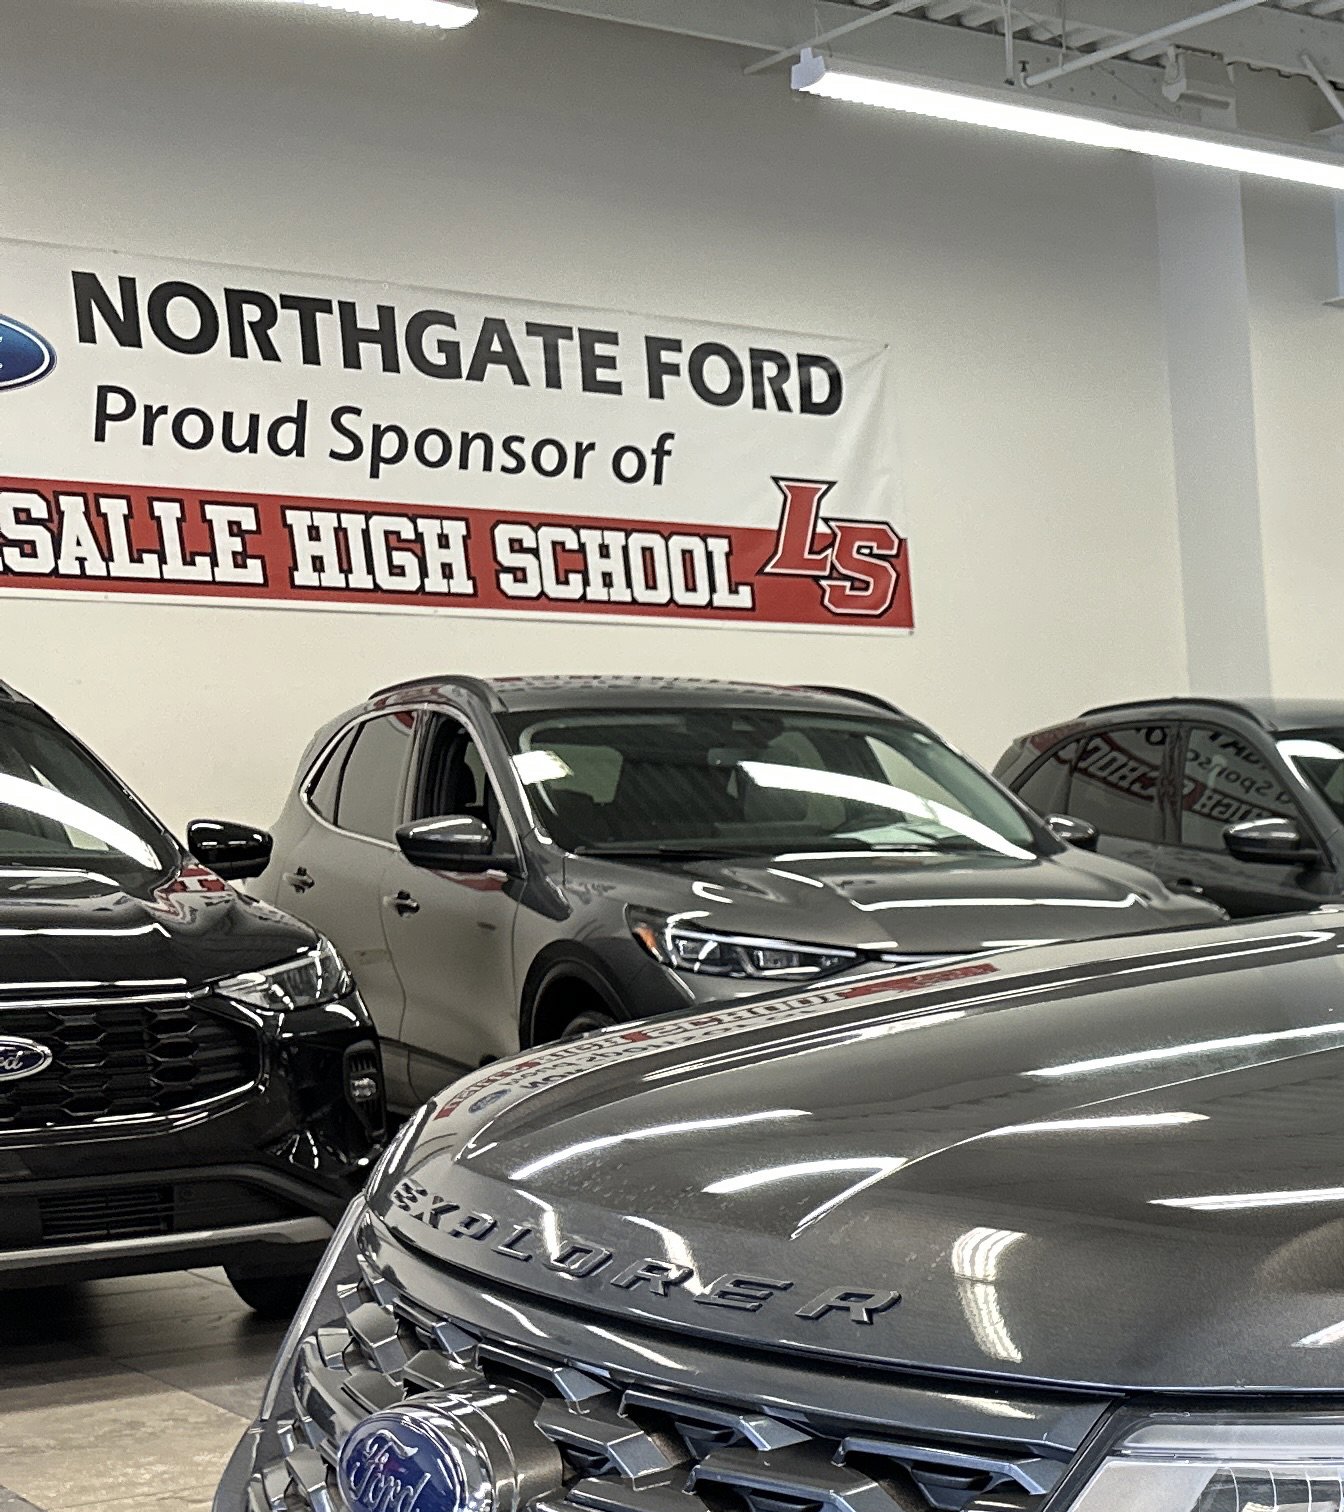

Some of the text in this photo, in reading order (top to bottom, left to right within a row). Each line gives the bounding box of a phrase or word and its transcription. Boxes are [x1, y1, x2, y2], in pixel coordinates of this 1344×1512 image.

[71, 270, 844, 417] NORTHGATE FORD
[93, 384, 675, 486] Proud Sponsor of
[0, 489, 754, 611] SALLE HIGH SCHOOL
[758, 476, 902, 619] LS
[391, 1178, 903, 1325] EXPLORER
